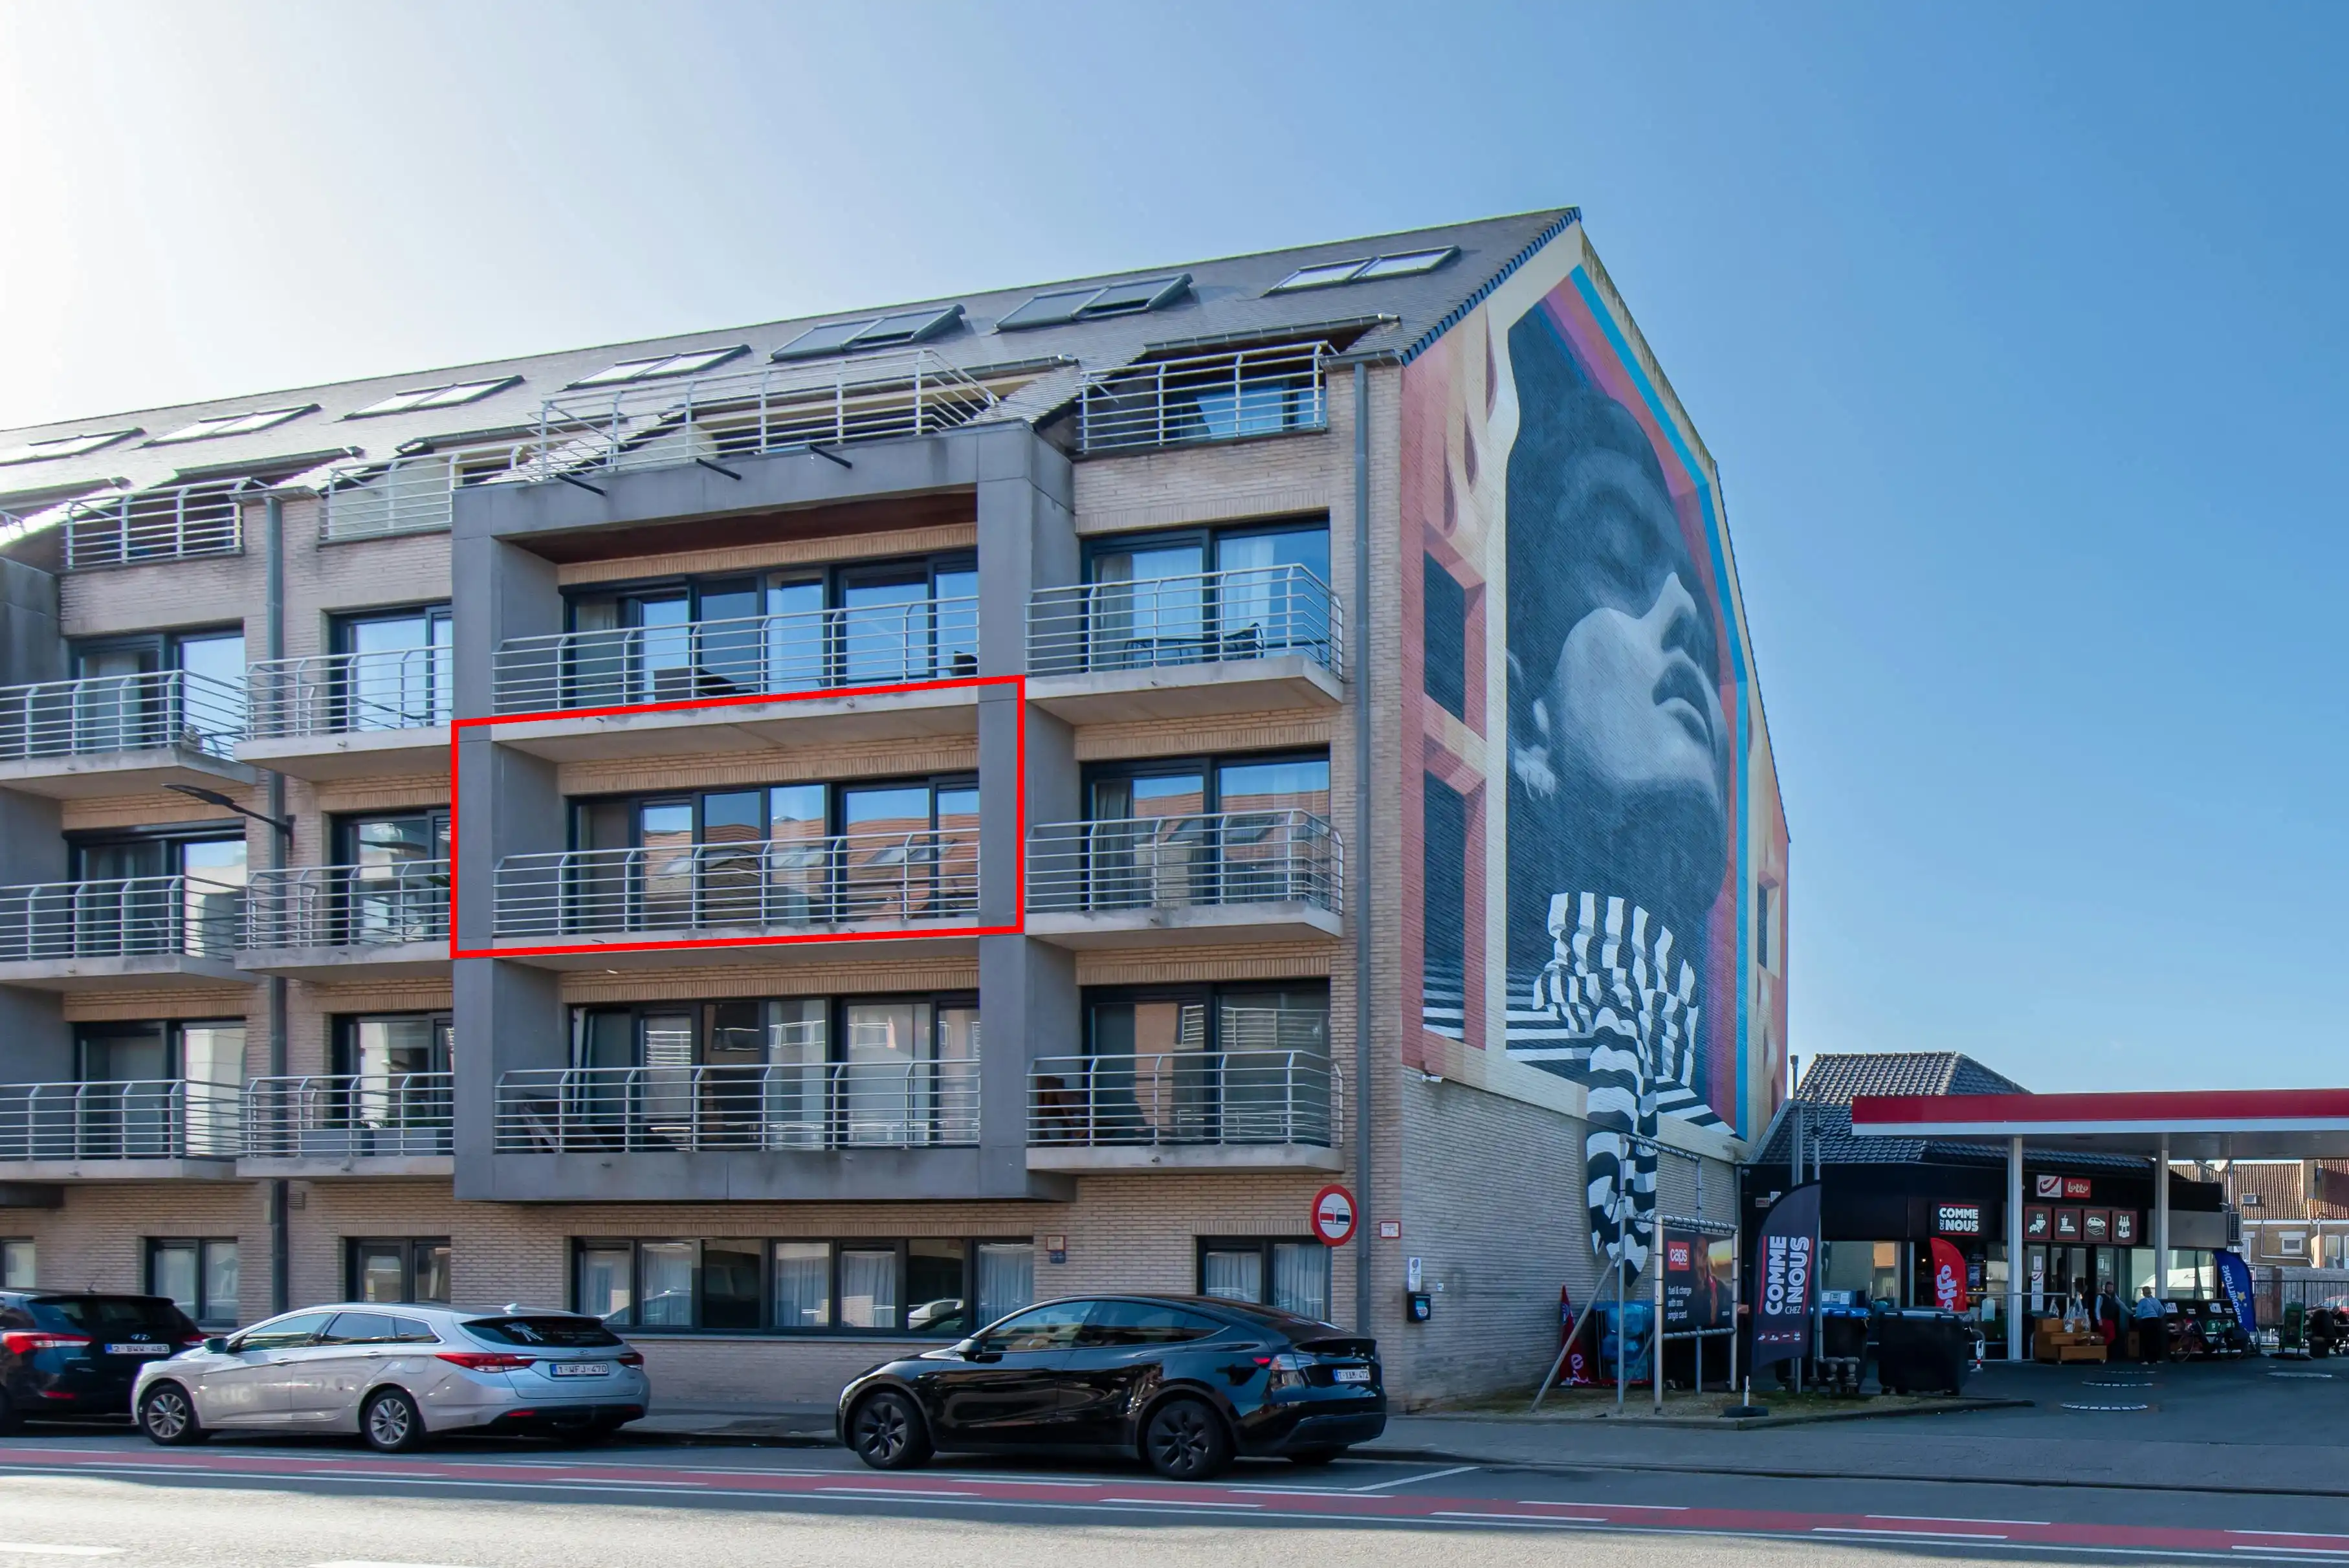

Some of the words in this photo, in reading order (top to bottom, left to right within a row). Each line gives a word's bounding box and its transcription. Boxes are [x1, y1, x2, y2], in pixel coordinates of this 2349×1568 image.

[1939, 1208, 1978, 1219] COMME
[1945, 1220, 1979, 1232] NOUS
[1670, 1248, 1688, 1264] caps
[1765, 1236, 1787, 1315] COMME
[1786, 1237, 1809, 1303] NOUS
[1785, 1306, 1801, 1314] CHEZ
